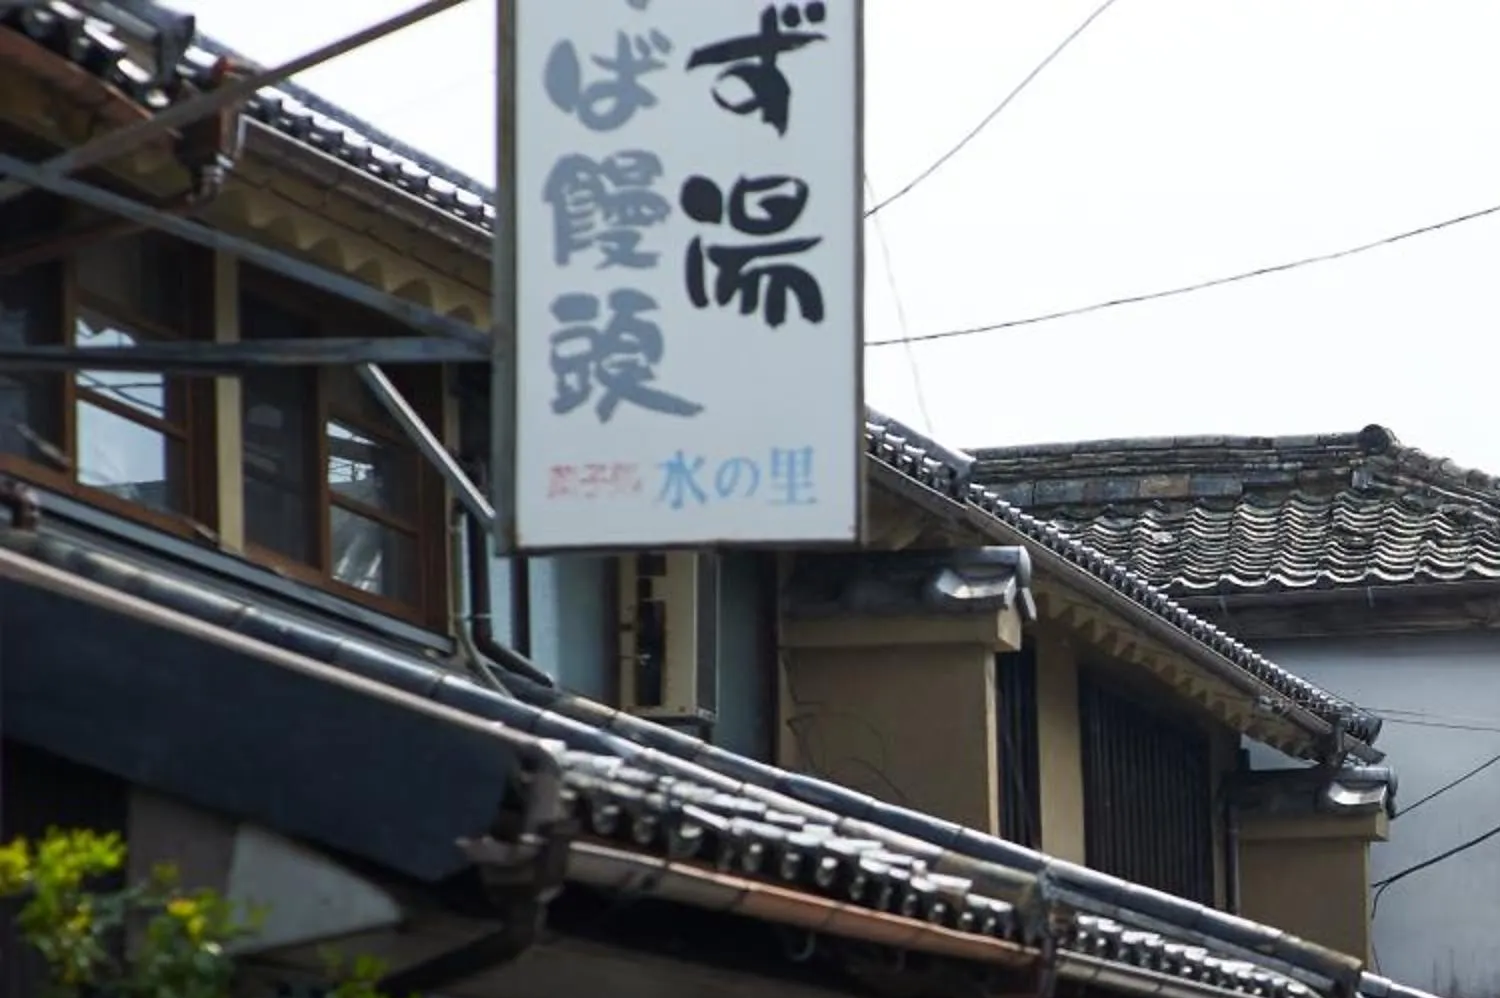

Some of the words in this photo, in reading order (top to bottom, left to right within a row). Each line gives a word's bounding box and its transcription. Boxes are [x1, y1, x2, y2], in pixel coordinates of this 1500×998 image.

[541, 0, 705, 423] ば饅頭
[652, 447, 817, 509] 水の里
